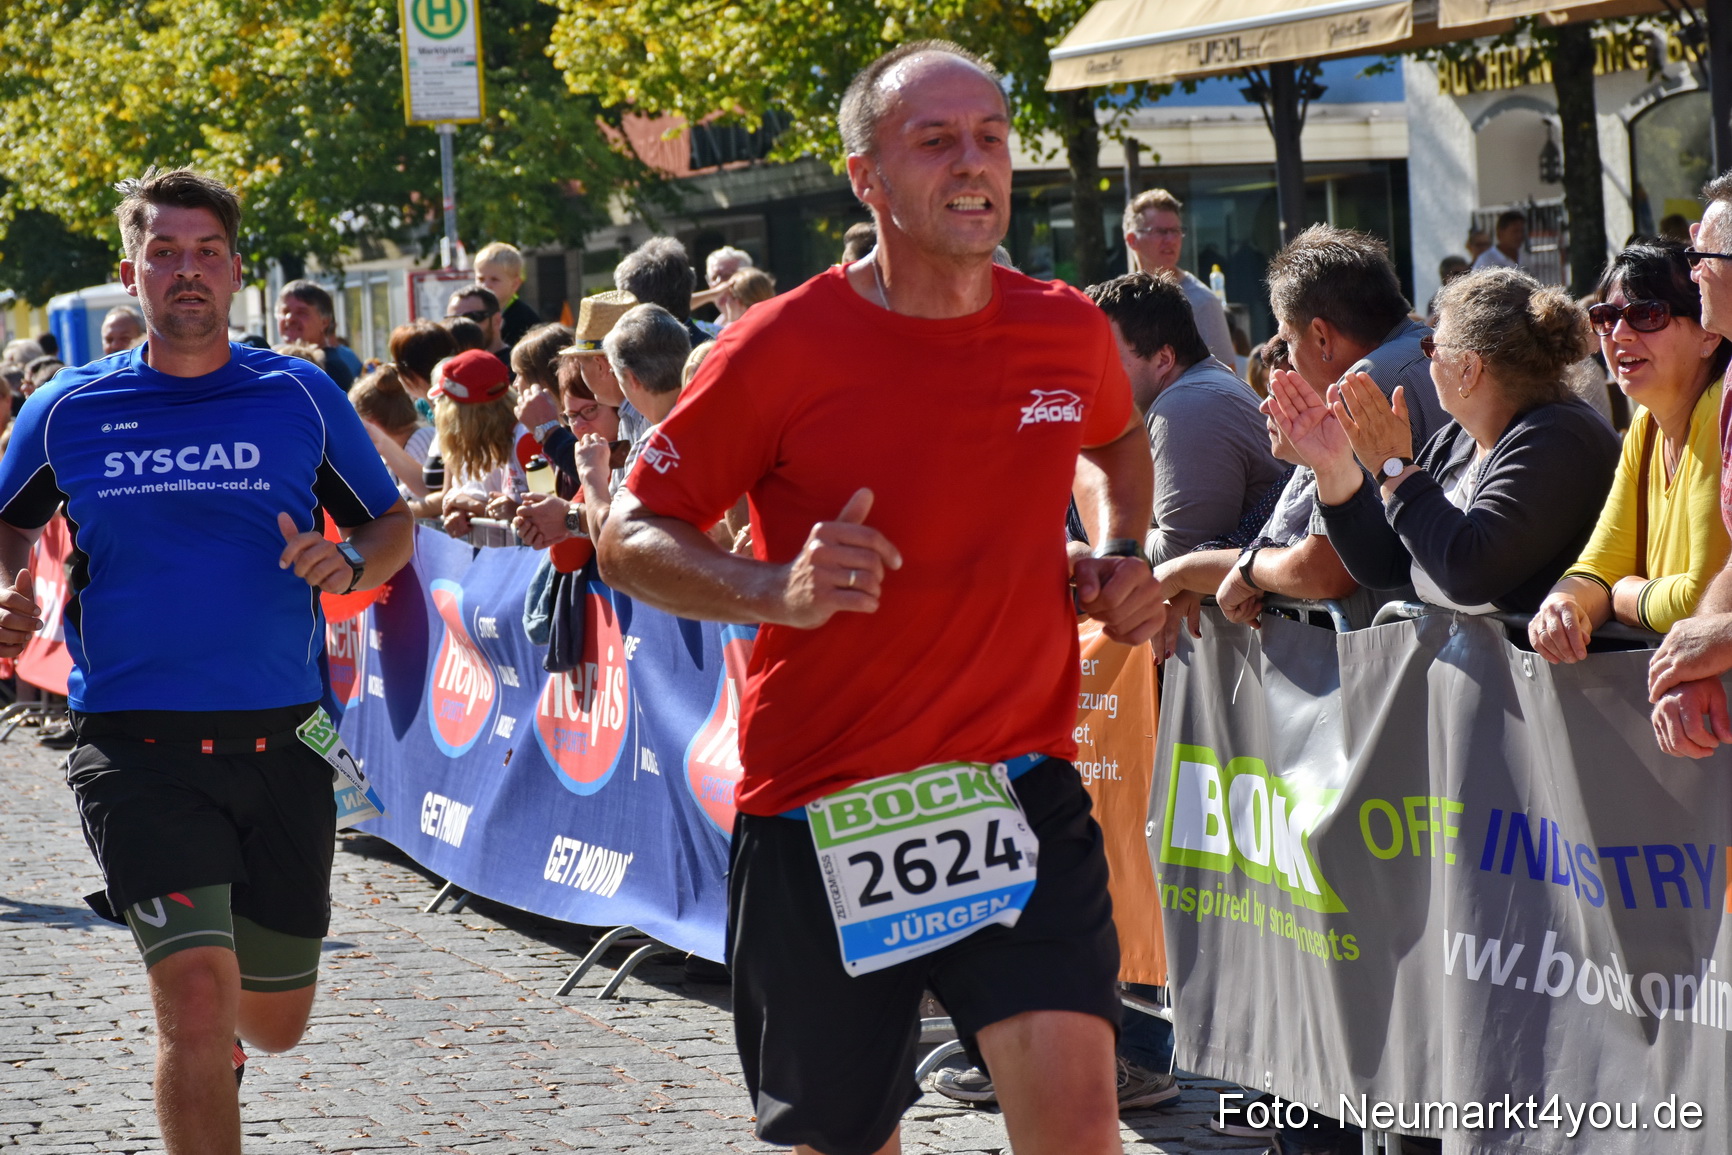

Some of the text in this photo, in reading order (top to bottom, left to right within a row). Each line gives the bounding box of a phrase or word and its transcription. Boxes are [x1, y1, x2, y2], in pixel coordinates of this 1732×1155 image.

[114, 421, 139, 431] JAKO
[103, 442, 261, 478] SYSCAD
[97, 478, 271, 498] www.metallbau-cad.de
[1080, 658, 1099, 676] er
[1078, 692, 1118, 719] zung
[420, 791, 450, 838] GET
[828, 766, 998, 832] BOCK
[543, 834, 583, 884] GET
[847, 819, 1023, 908] 2624
[883, 894, 1012, 947] JÜRGEN
[1157, 872, 1250, 923] inspired
[1253, 890, 1267, 937] by
